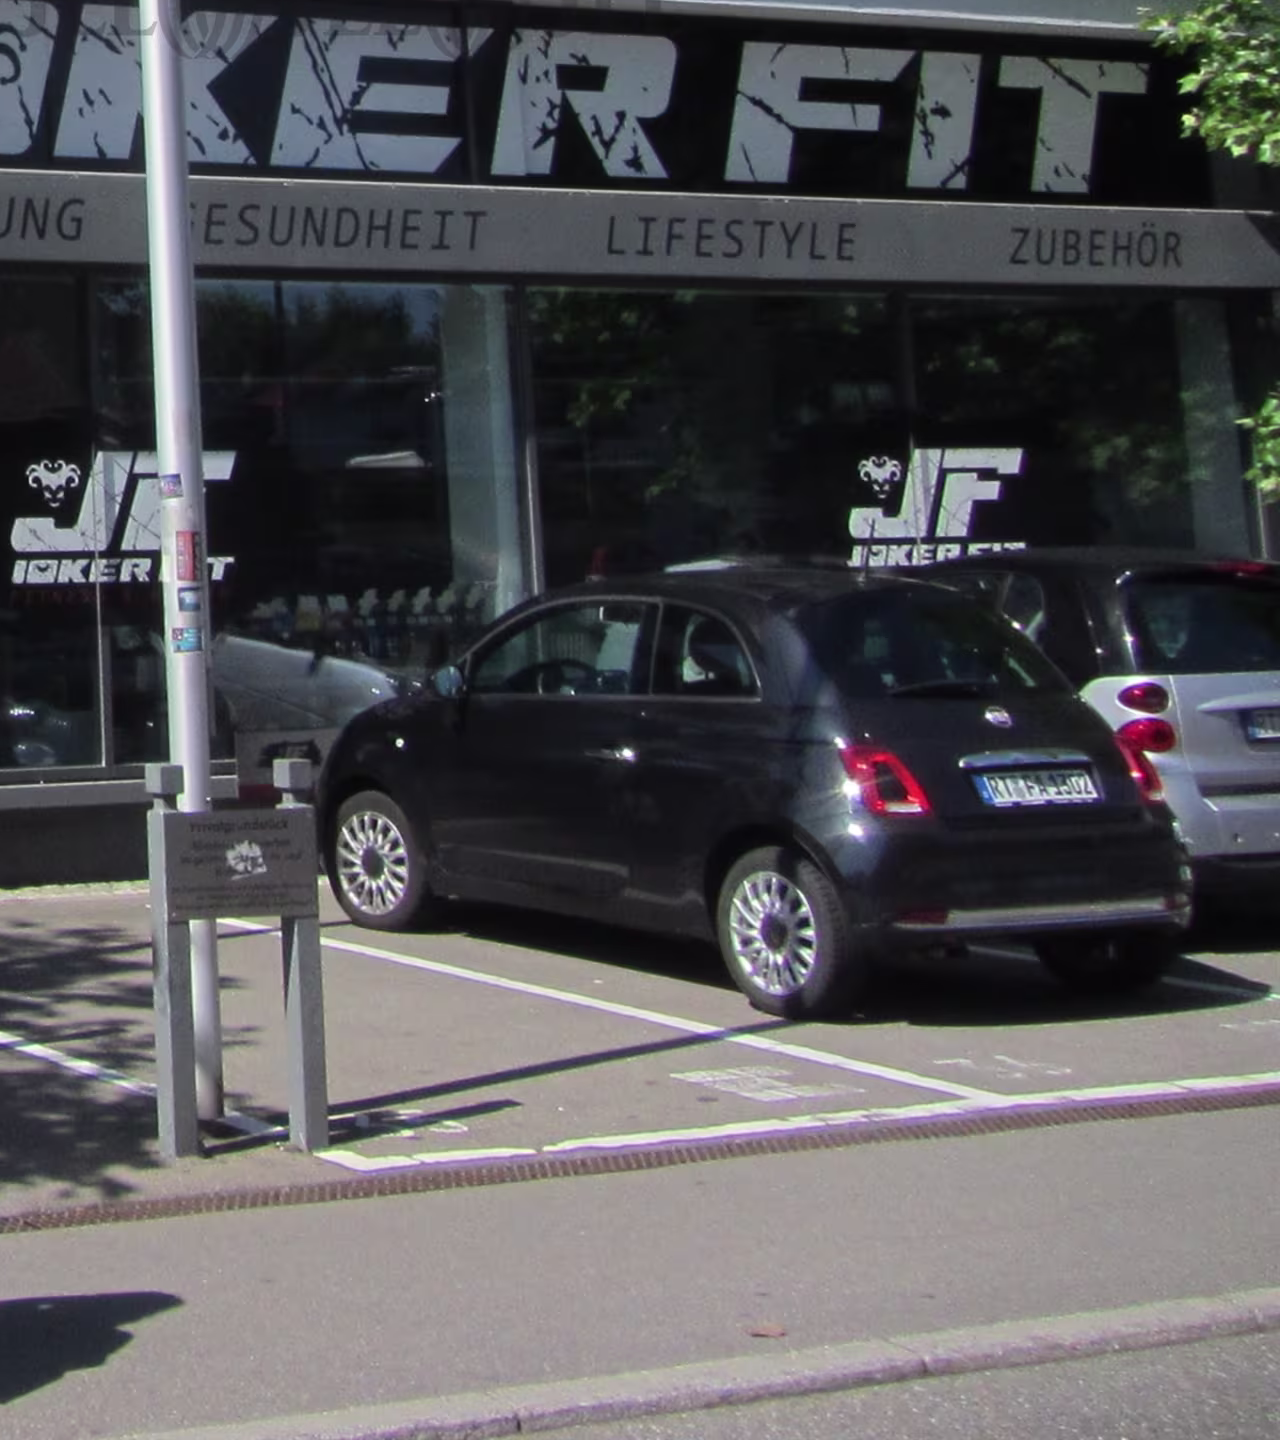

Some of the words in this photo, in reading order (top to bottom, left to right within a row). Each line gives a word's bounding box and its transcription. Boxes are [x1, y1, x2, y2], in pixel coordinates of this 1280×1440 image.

[724, 40, 1152, 194] FIT
[190, 202, 488, 251] ESUNDHEIT
[605, 213, 857, 263] LIFESTYLE
[1008, 220, 1184, 268] ZUBEHÖR
[848, 447, 1023, 539] JF
